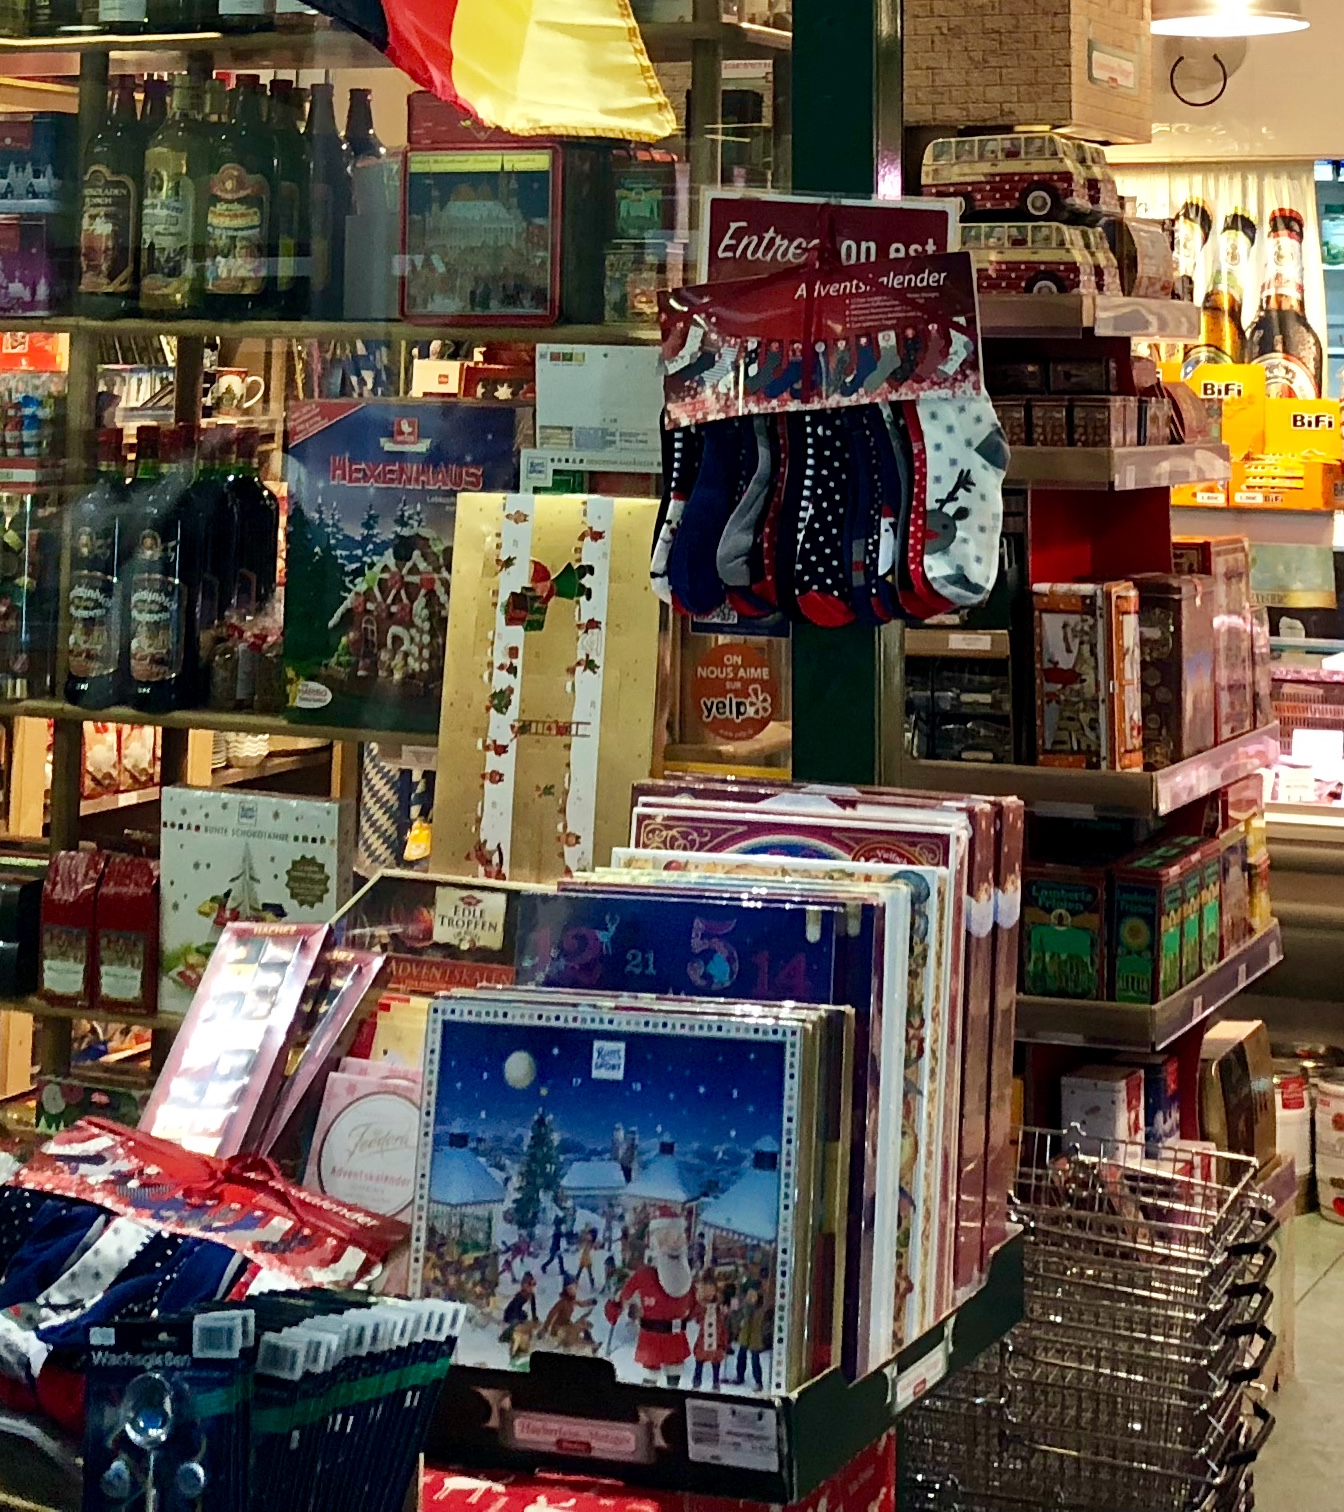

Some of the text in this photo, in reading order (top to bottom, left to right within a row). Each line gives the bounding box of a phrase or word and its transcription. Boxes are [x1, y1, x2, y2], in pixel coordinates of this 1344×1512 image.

[840, 239, 877, 266] on
[1201, 381, 1244, 398] BiFi
[1291, 413, 1335, 430] BiFi
[329, 455, 485, 492] HEXENHAUS
[723, 654, 742, 666] ON
[697, 666, 770, 680] NOUS AIME
[701, 694, 749, 722] yelp
[453, 904, 487, 920] EDLE
[437, 914, 499, 934] TROPFEN
[624, 948, 656, 976] 21
[686, 917, 740, 989] 5
[386, 957, 514, 987] ADVENTSKALEN
